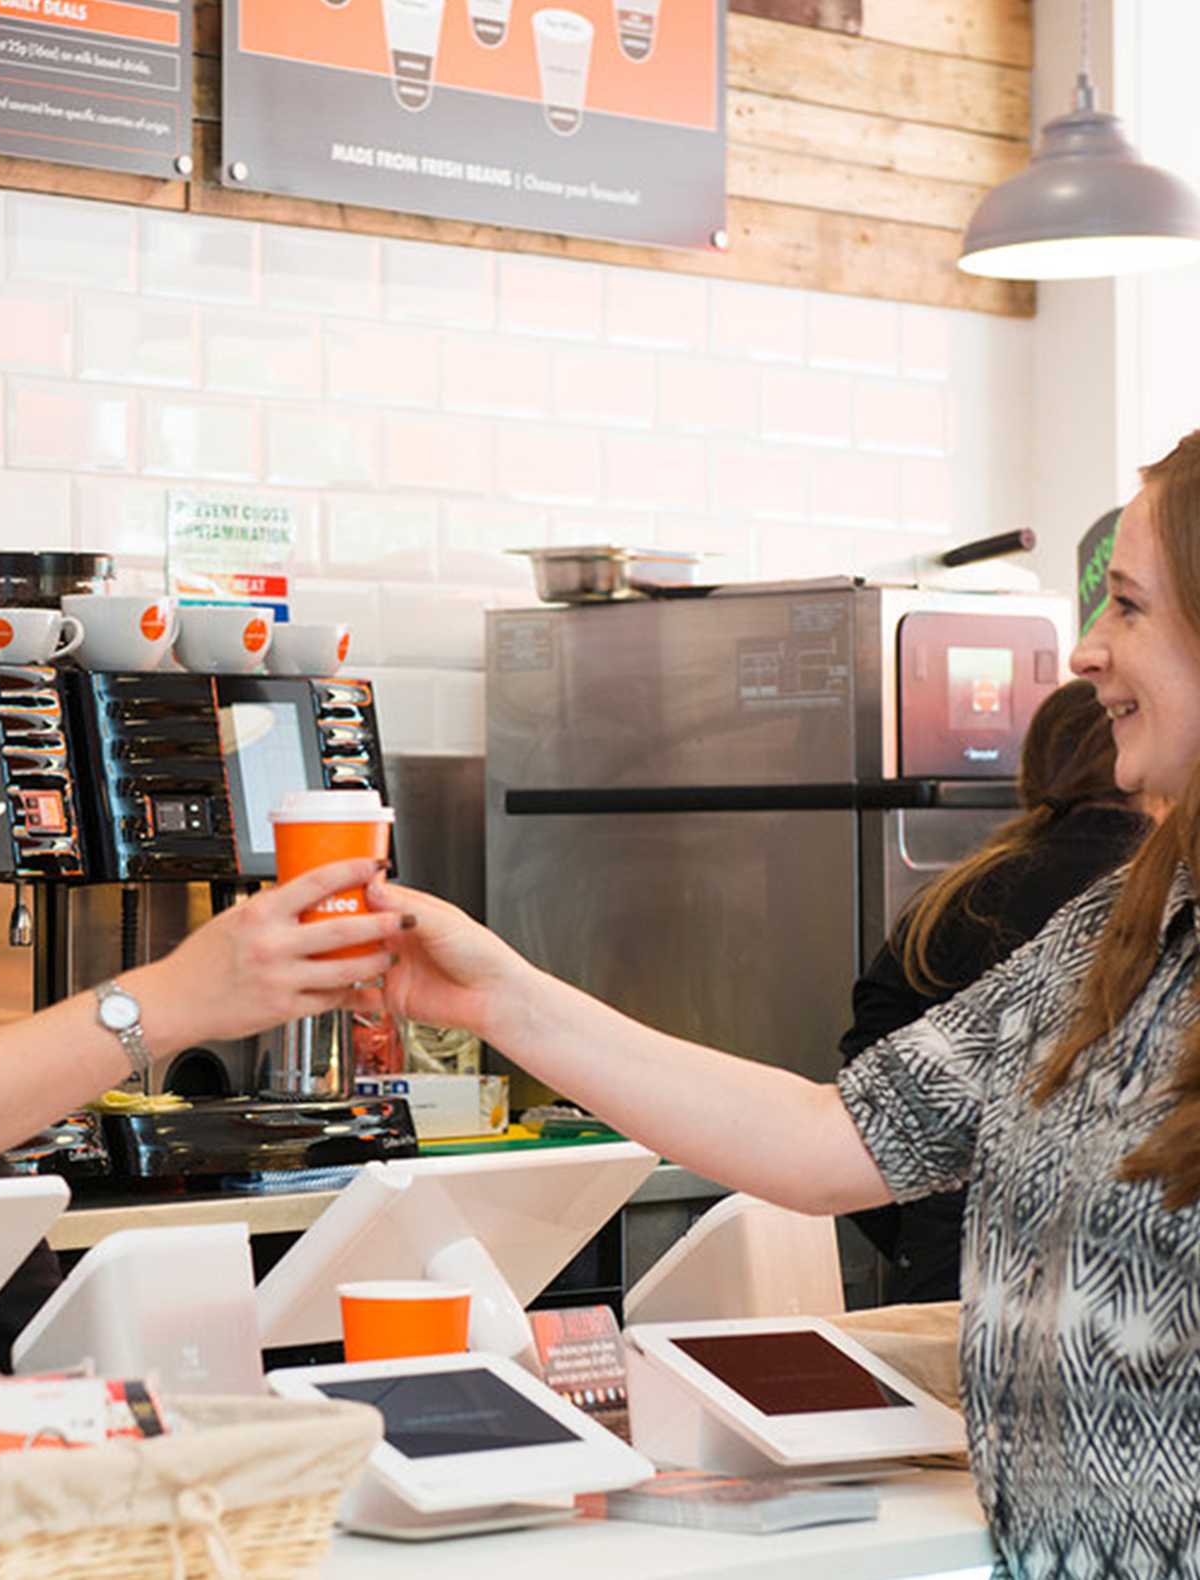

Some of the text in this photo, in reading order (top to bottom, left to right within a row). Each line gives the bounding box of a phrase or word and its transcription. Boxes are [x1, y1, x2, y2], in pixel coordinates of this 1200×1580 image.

[331, 143, 374, 167] MADE
[376, 149, 418, 173] FROM
[420, 156, 464, 180] FRESH
[465, 163, 512, 188] BEANS
[523, 173, 564, 196] Choose
